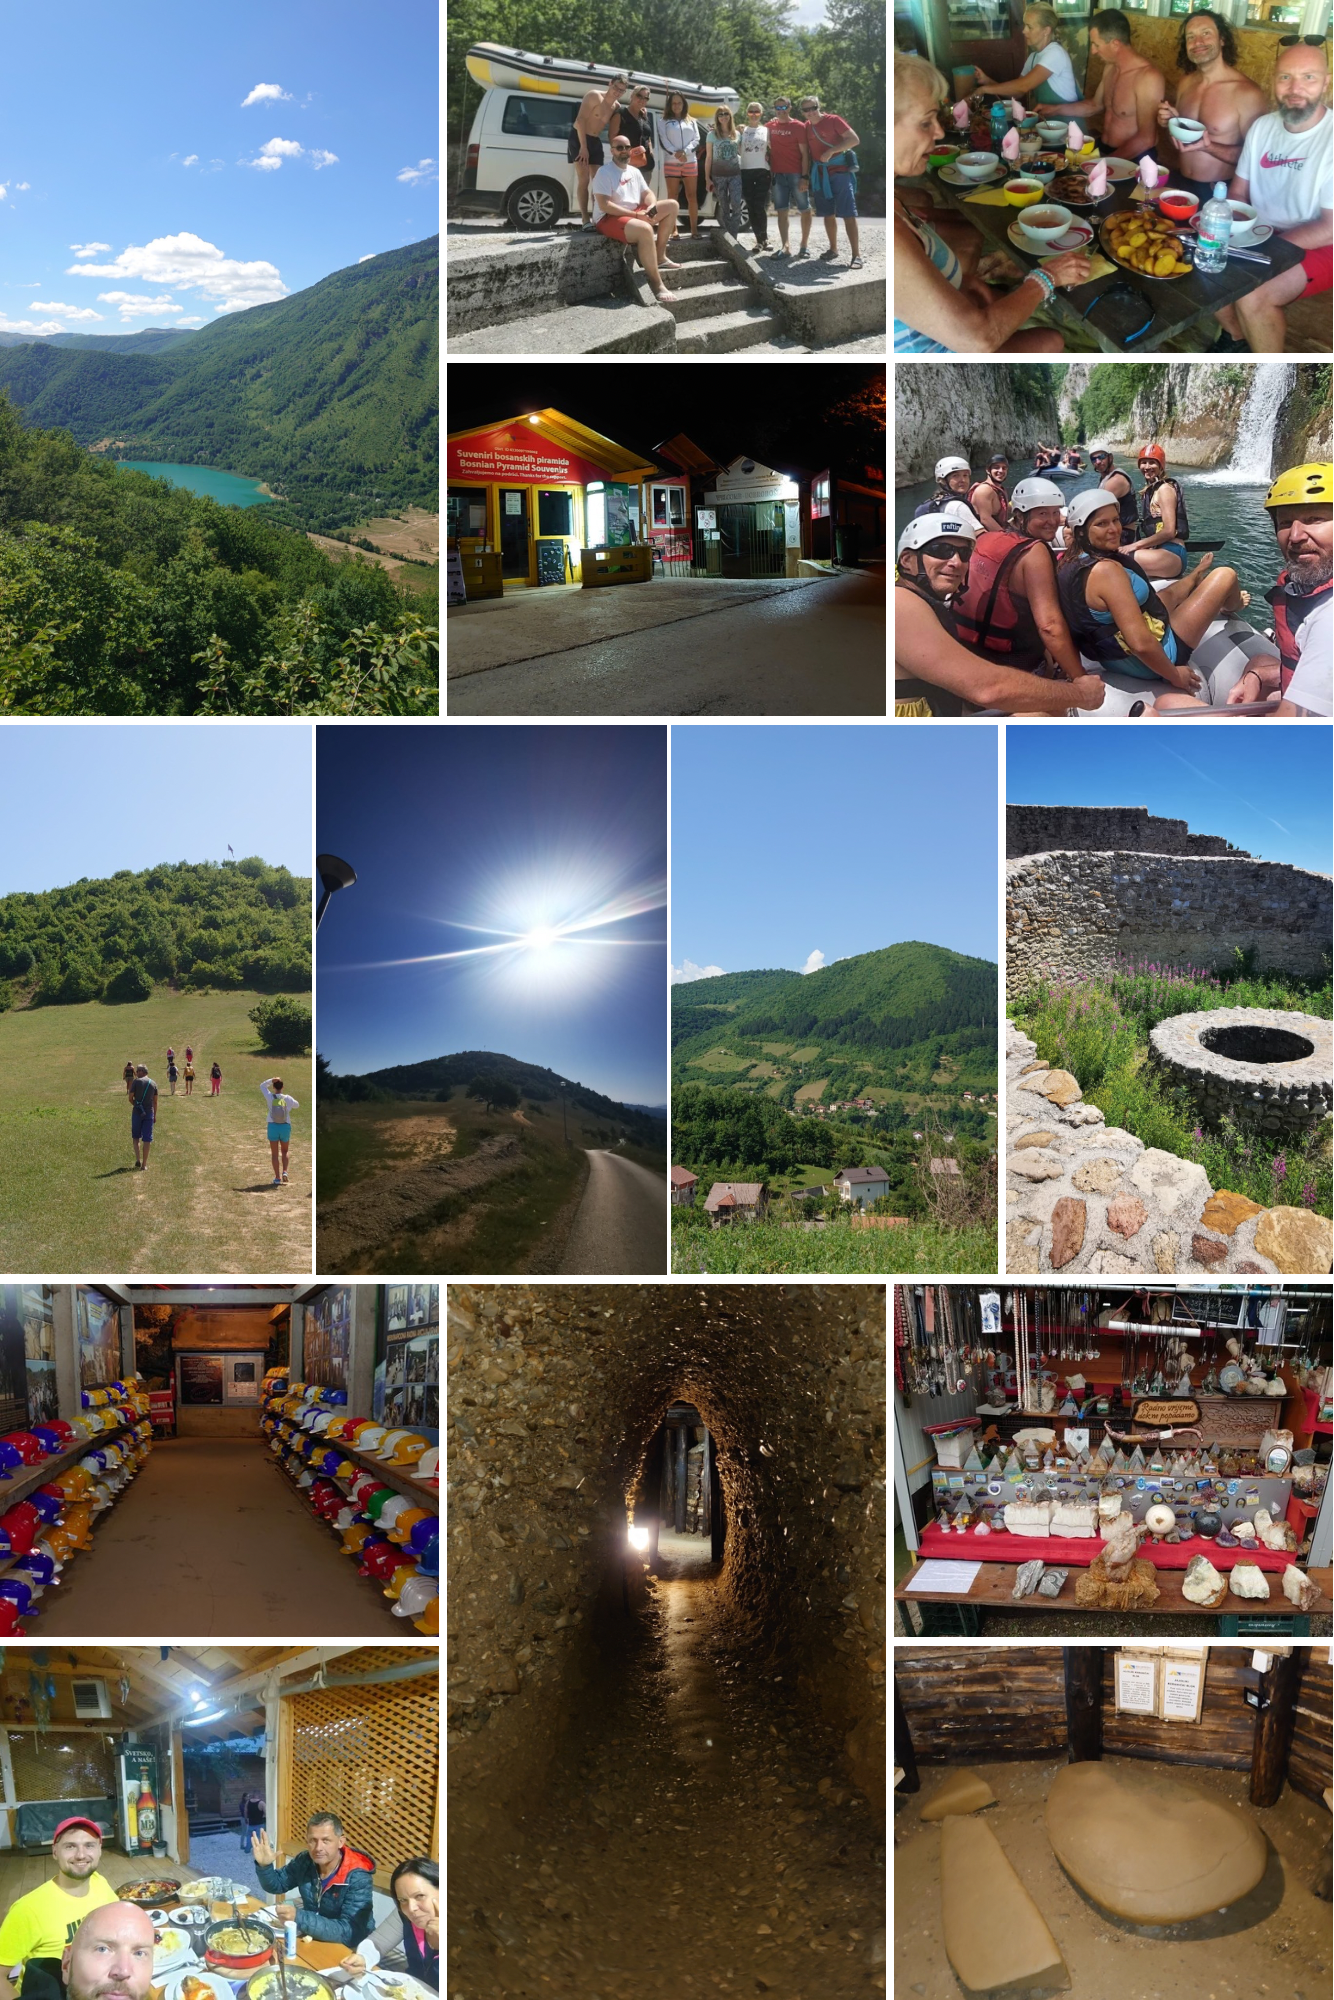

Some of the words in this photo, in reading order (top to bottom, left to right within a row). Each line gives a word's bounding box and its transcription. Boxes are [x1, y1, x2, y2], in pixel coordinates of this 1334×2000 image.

[456, 449, 493, 459] Suveniri
[494, 452, 535, 463] bosanskih
[537, 456, 570, 466] piramida
[460, 459, 495, 469] Bosnian
[496, 462, 530, 471] Pyramid
[531, 464, 568, 474] Souvenirs
[1141, 1402, 1167, 1415] Radno
[1167, 1403, 1194, 1413] vrijeme
[140, 1819, 155, 1831] MB
